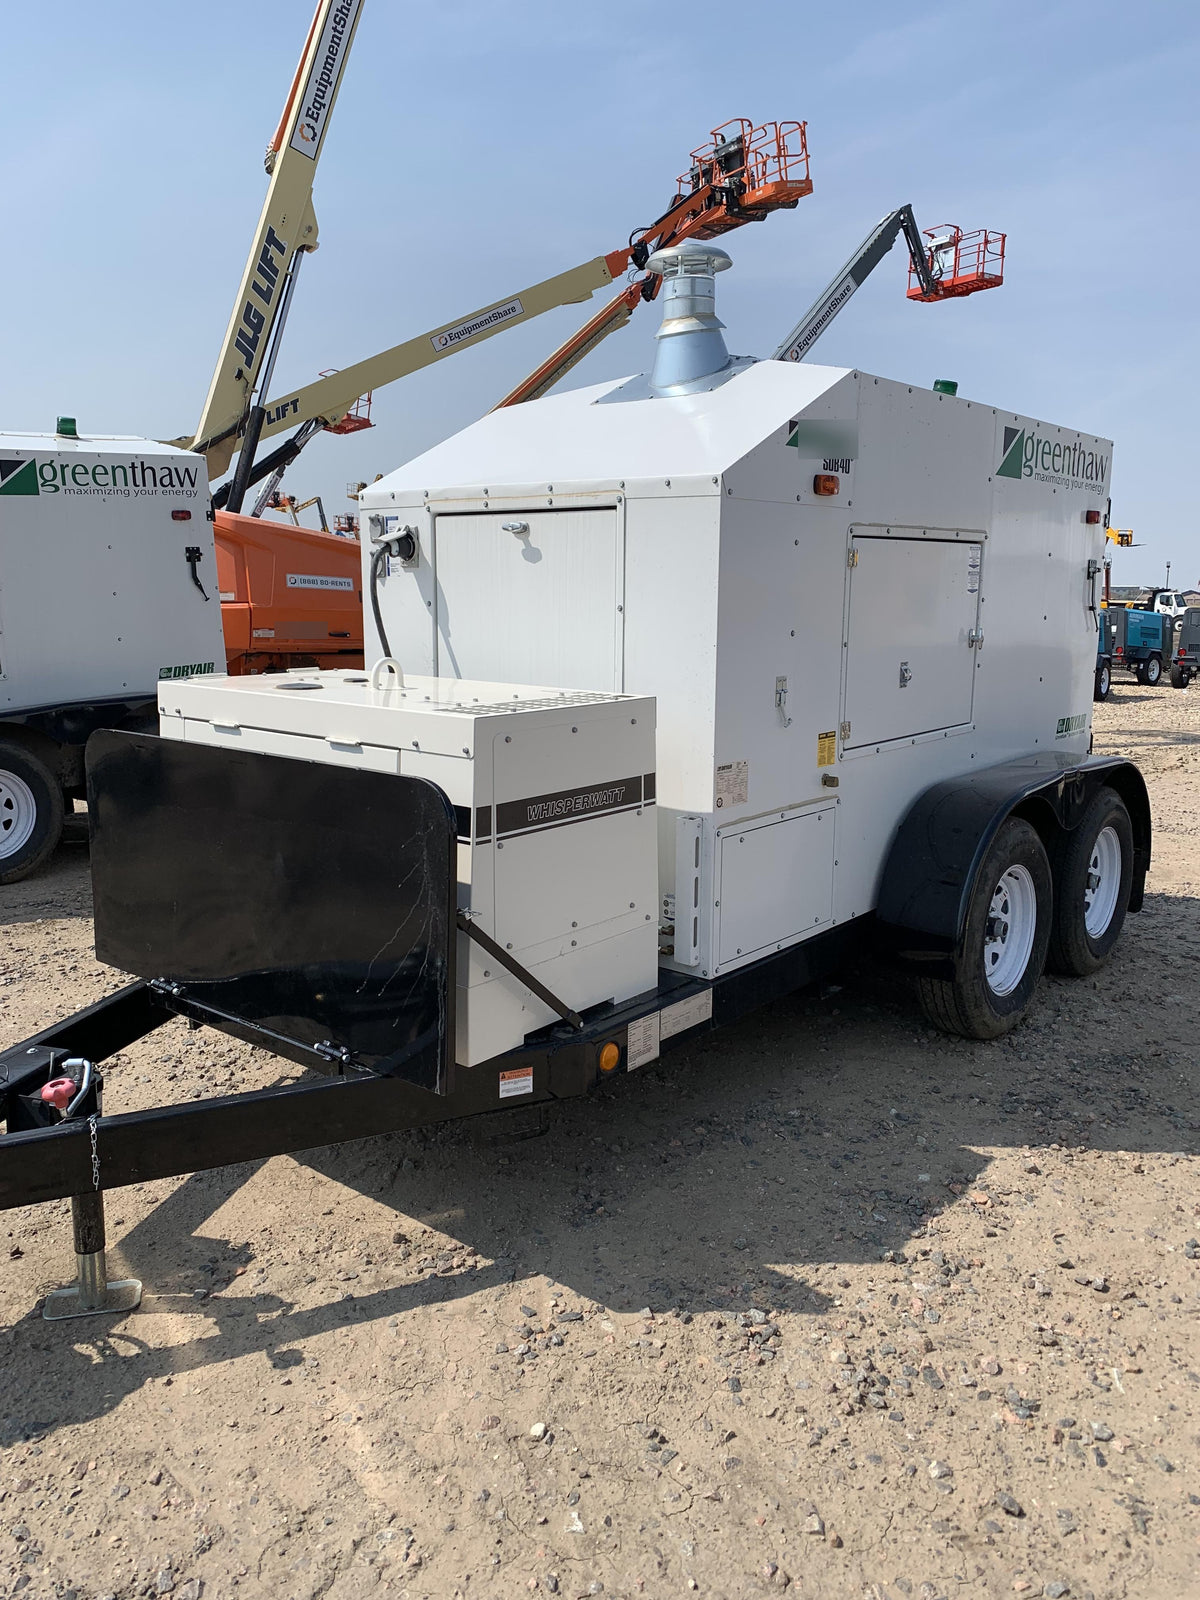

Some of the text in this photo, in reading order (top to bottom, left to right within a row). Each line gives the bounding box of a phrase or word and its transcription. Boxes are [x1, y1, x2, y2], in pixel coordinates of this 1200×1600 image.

[234, 224, 287, 370] JLG LIFT
[447, 305, 517, 342] EquipmentShare
[797, 284, 852, 352] EquipmentShare
[266, 398, 299, 425] LIFT
[1023, 432, 1108, 482] greenthaw
[39, 460, 198, 493] greenthaw
[64, 487, 198, 498] maximizing your energy
[1034, 472, 1105, 495] maximizing your energy
[173, 662, 215, 678] DRYAIR
[527, 786, 625, 822] WHISPERWATT
